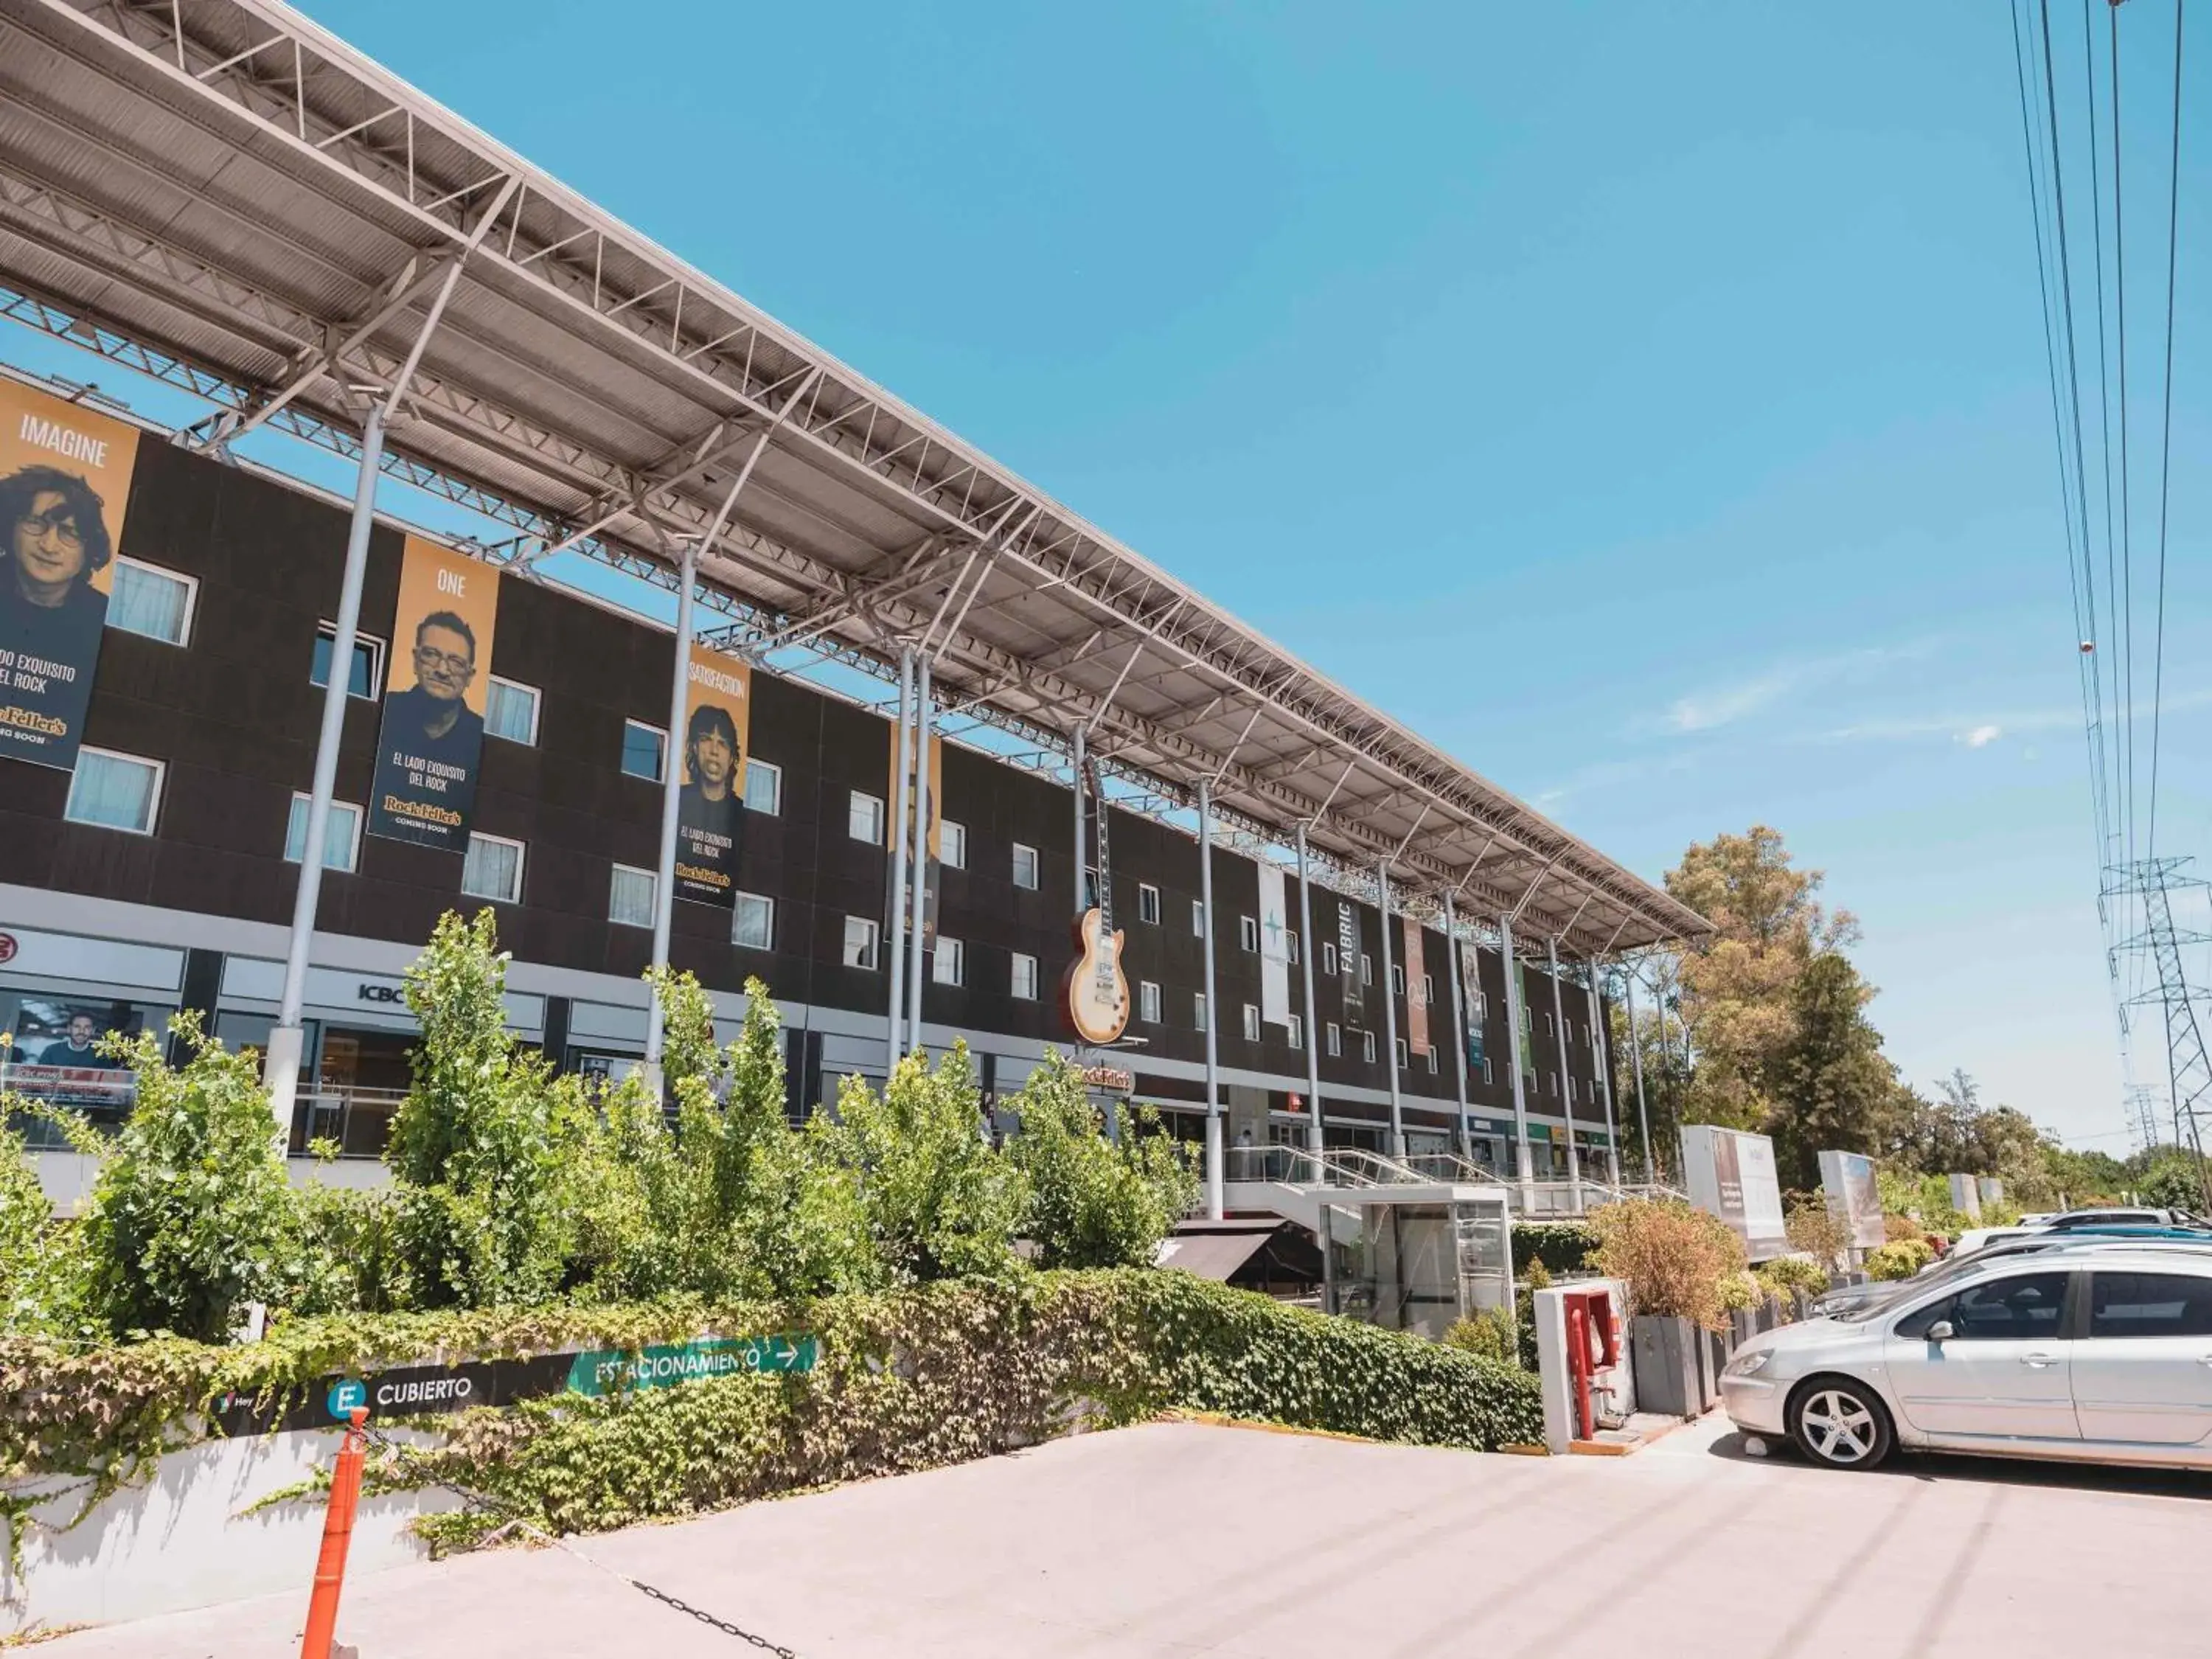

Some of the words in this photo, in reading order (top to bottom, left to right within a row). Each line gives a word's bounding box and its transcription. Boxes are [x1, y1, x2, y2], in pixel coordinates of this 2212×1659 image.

[20, 414, 108, 468] IMAGINE
[437, 568, 466, 598] ONE
[14, 672, 47, 694] ROCK
[17, 654, 75, 683] EXQUISITO
[393, 751, 403, 766] EL
[405, 755, 425, 772] LADO
[427, 760, 466, 782] EXQUISITO
[409, 772, 423, 787] DEL
[425, 776, 448, 793] ROCK
[1338, 902, 1354, 973] FABRIC
[1074, 1064, 1132, 1089] ock&Feller's
[595, 1349, 760, 1384] ESTACIONAMIENO
[338, 1385, 357, 1412] E
[377, 1378, 472, 1405] CUBIERTO
